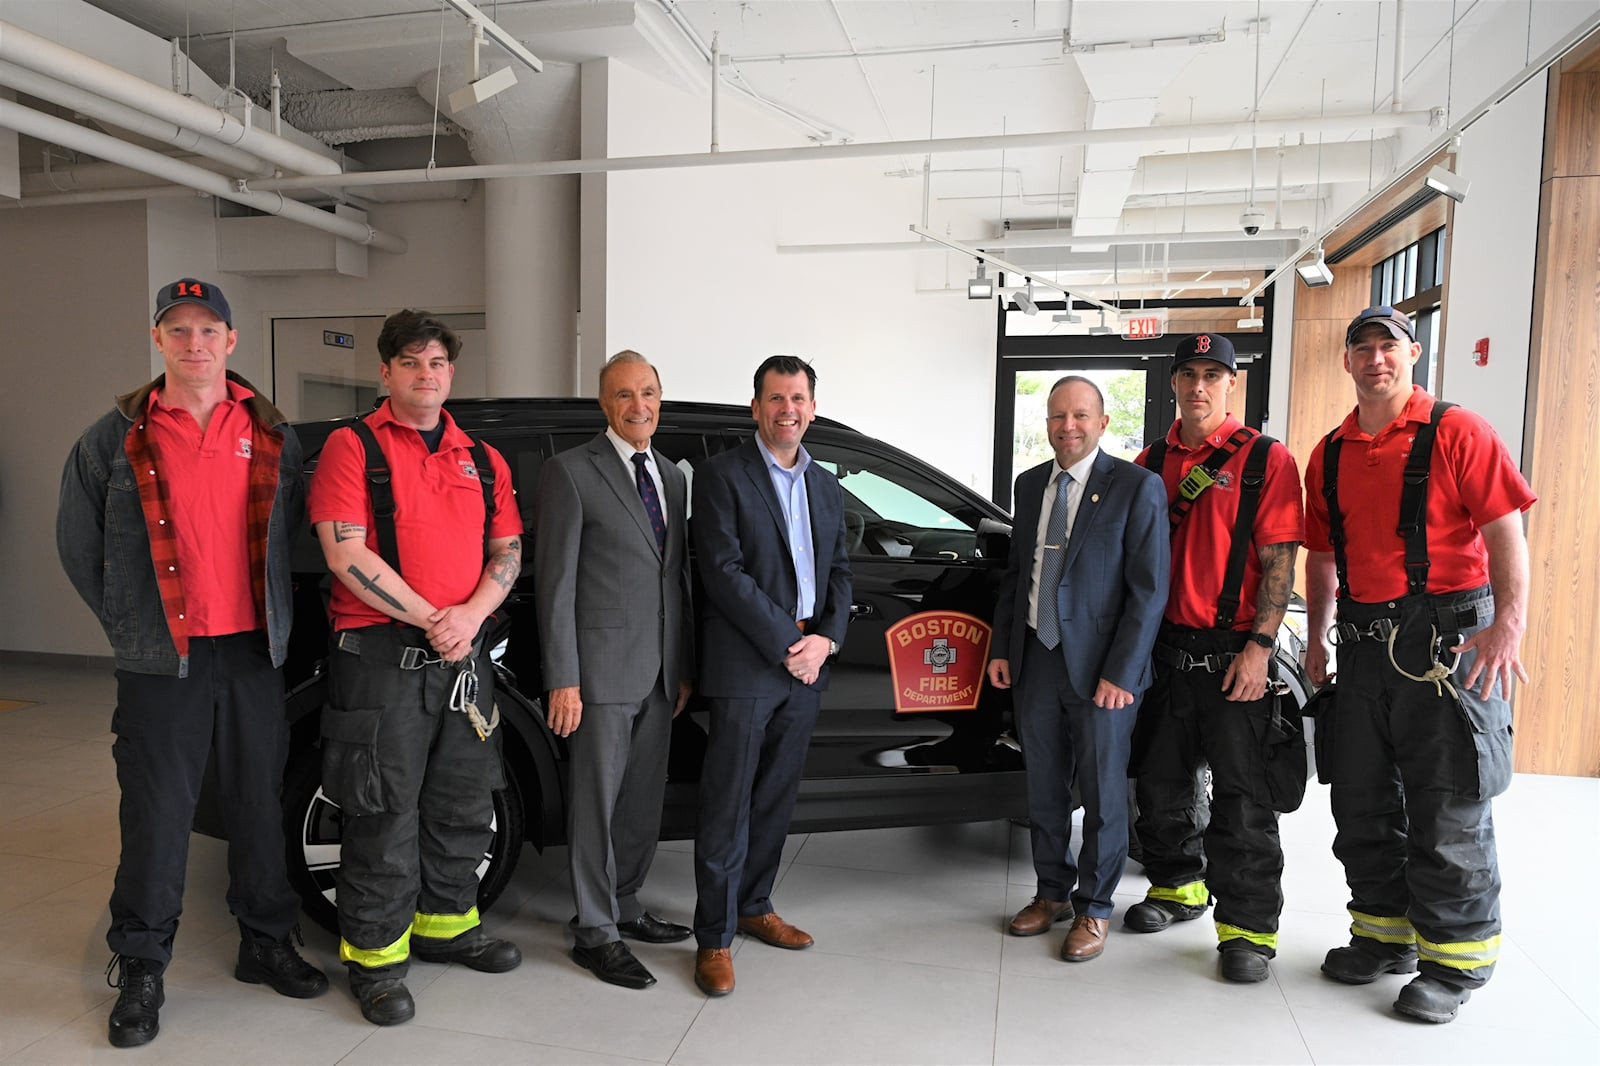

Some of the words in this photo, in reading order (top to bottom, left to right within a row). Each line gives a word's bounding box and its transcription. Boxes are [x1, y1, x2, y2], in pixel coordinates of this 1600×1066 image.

[178, 282, 203, 297] 14
[1129, 318, 1157, 338] EXIT
[1194, 335, 1211, 353] B
[896, 619, 983, 648] BOSTON
[919, 676, 958, 692] FIRE
[903, 685, 973, 705] DEPARTMENT
